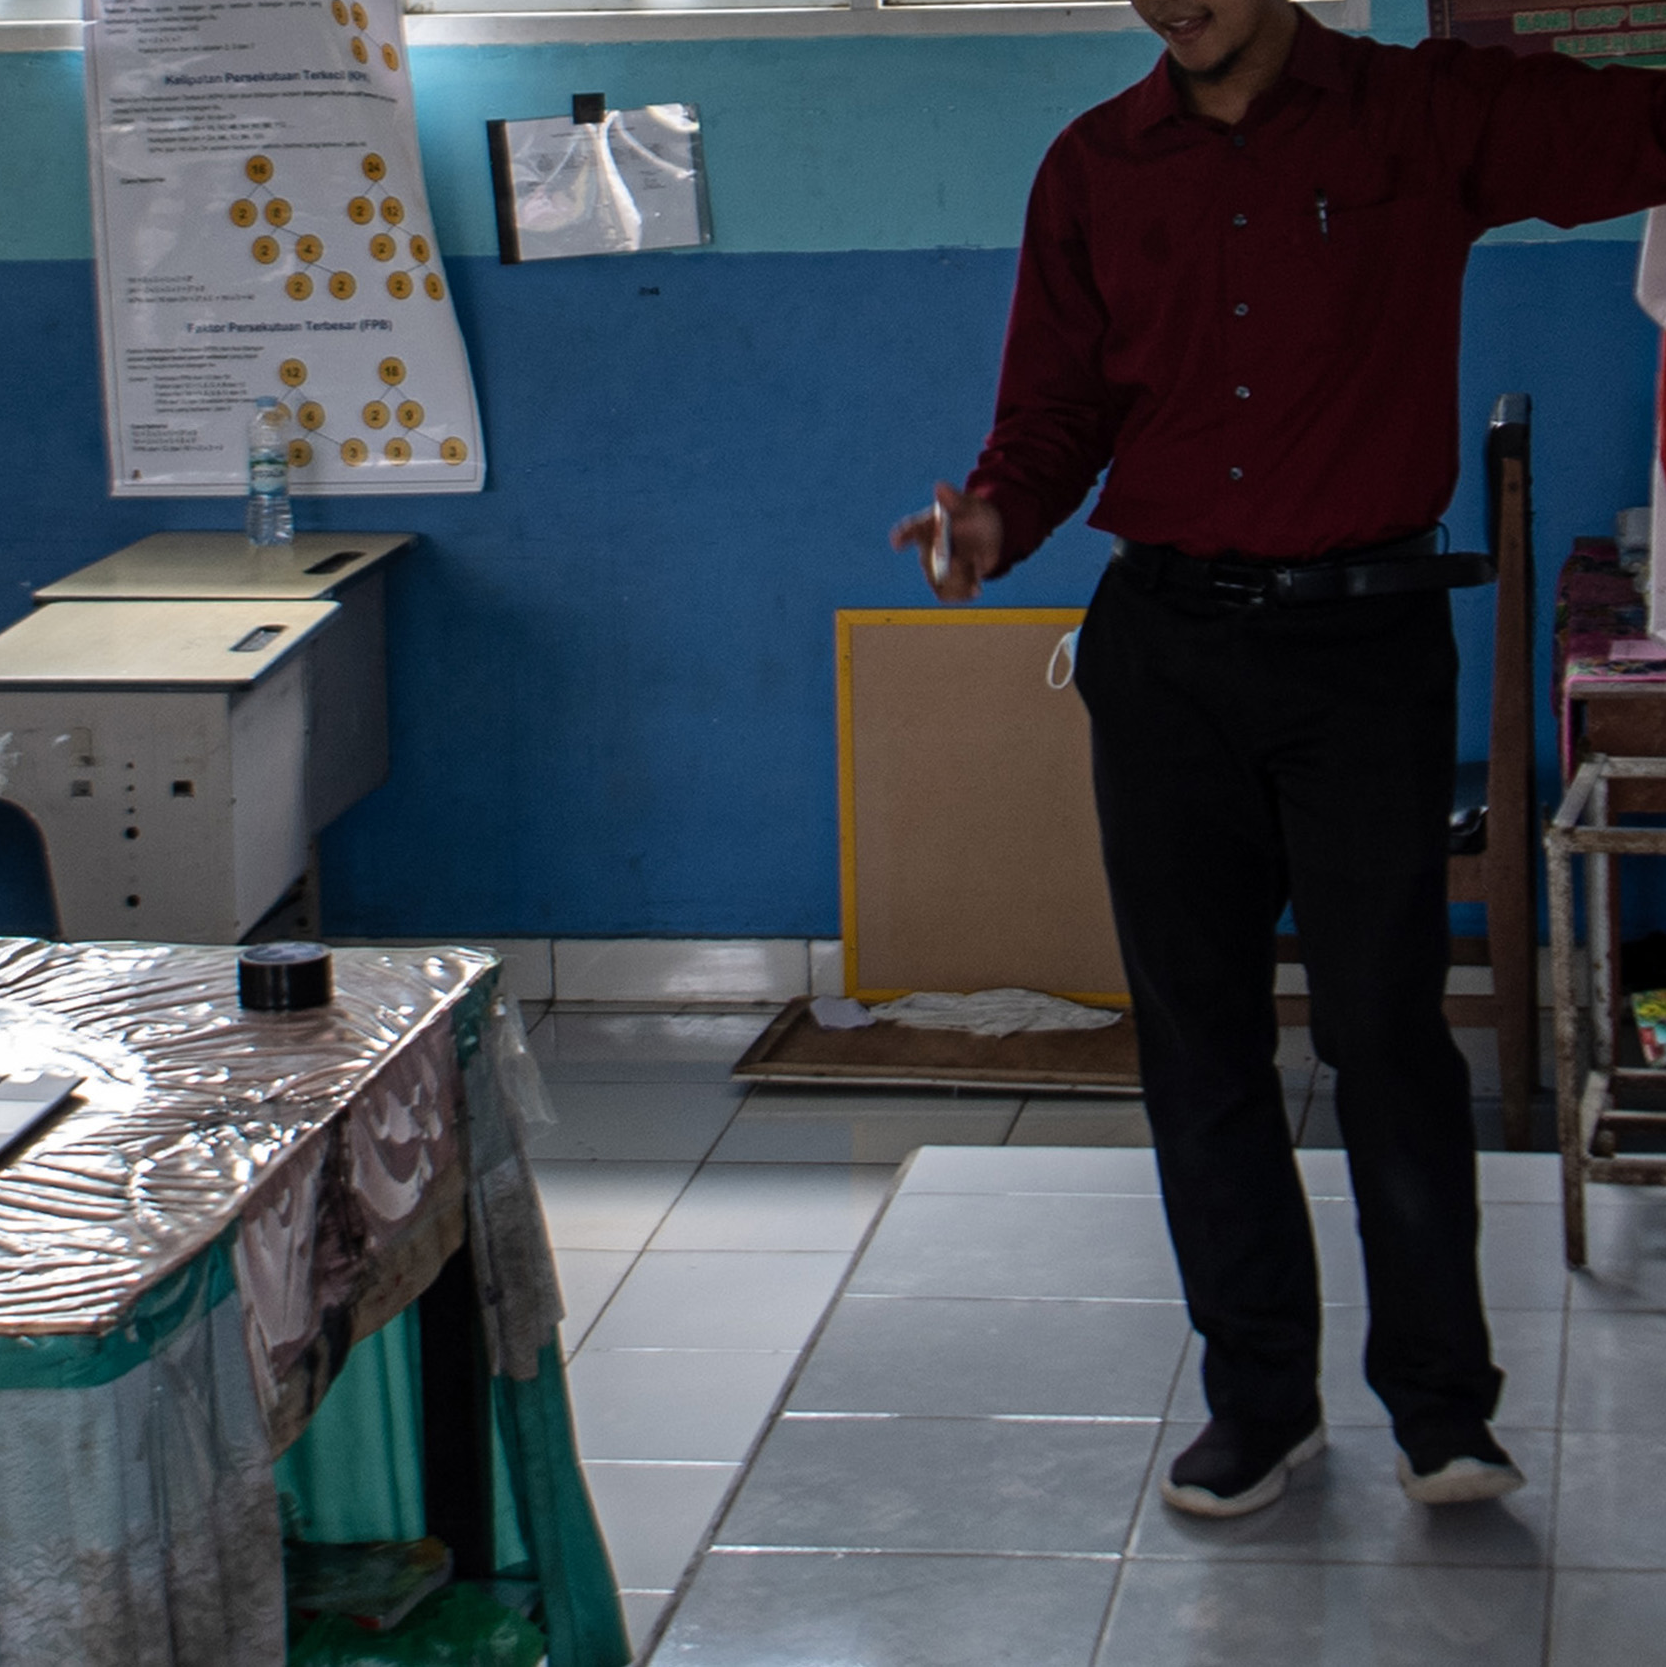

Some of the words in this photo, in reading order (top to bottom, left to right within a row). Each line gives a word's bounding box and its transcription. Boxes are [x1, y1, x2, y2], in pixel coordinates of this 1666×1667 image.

[187, 323, 226, 334] Faktor
[228, 322, 302, 333] Persekutuan
[306, 321, 356, 332] Terbesar
[360, 319, 393, 332] (FPB)
